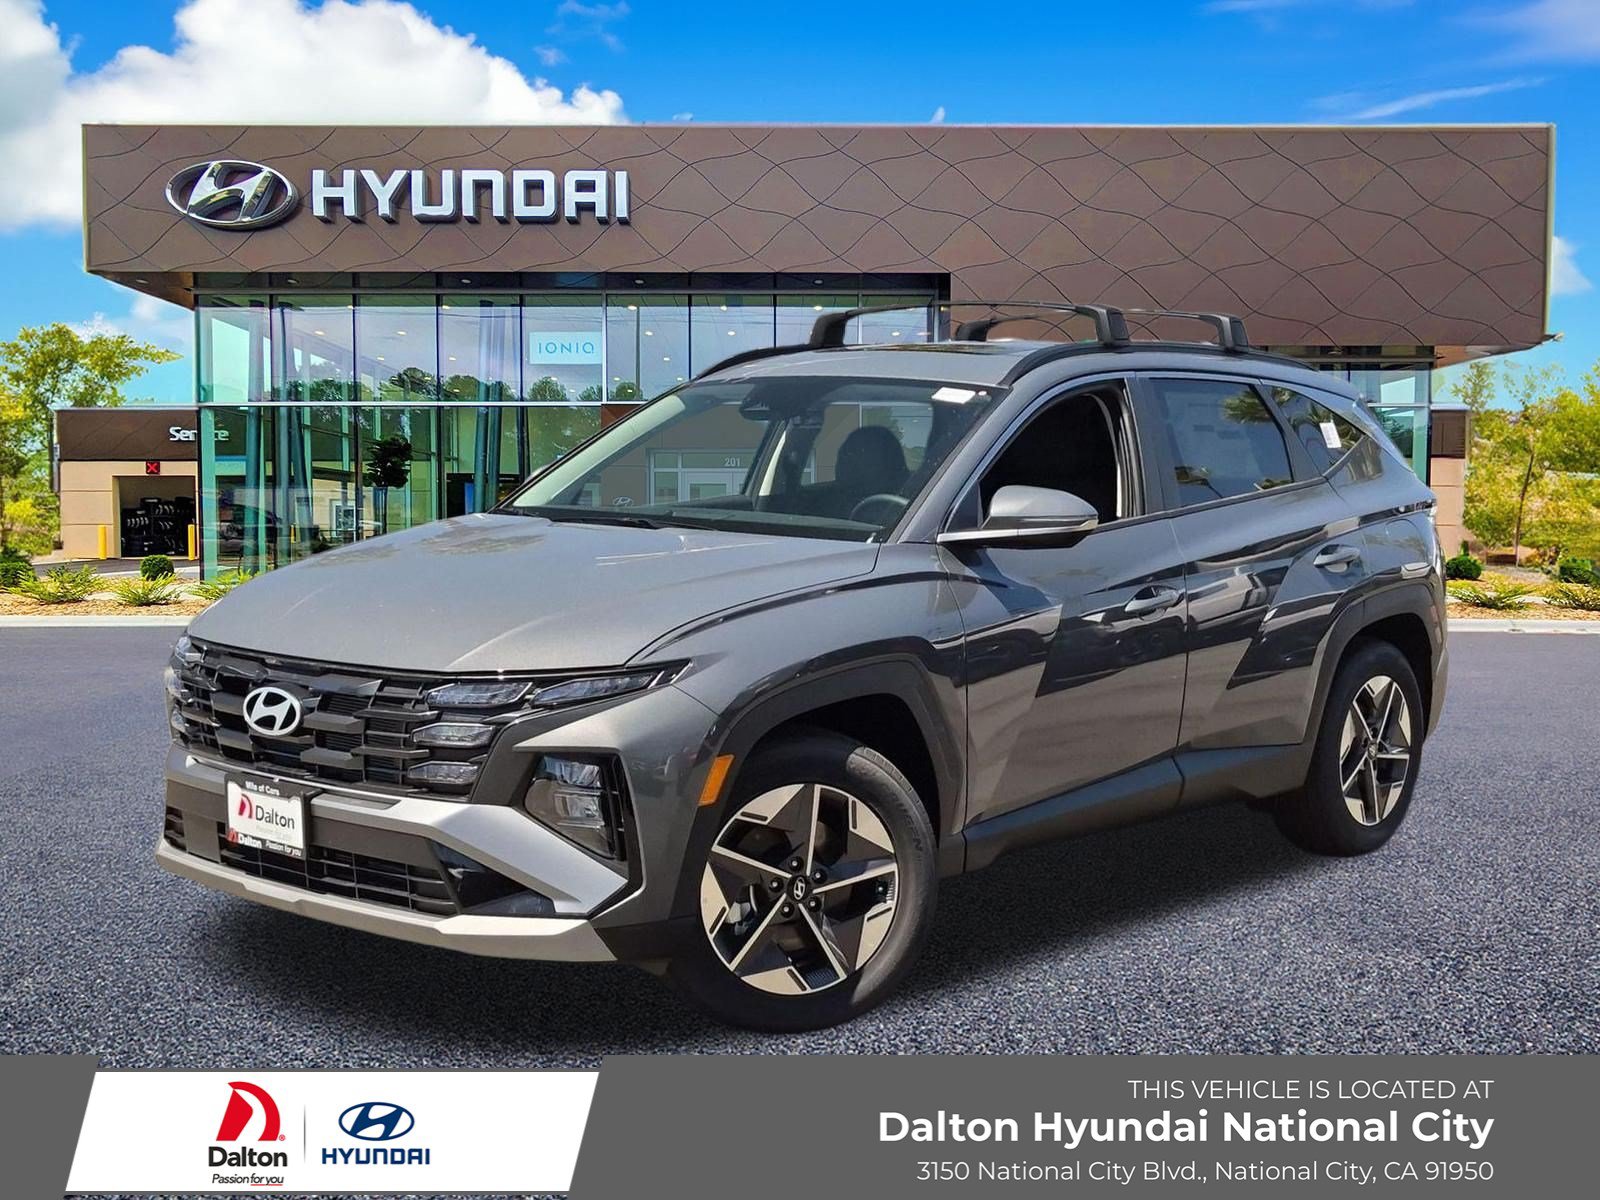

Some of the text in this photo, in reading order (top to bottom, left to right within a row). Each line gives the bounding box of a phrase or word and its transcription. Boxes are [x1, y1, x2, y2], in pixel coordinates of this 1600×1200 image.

[312, 169, 630, 222] HYUNDAI
[538, 342, 595, 354] IONIQ
[724, 457, 741, 467] 201
[255, 804, 295, 830] Dalton
[239, 833, 263, 849] Dalton
